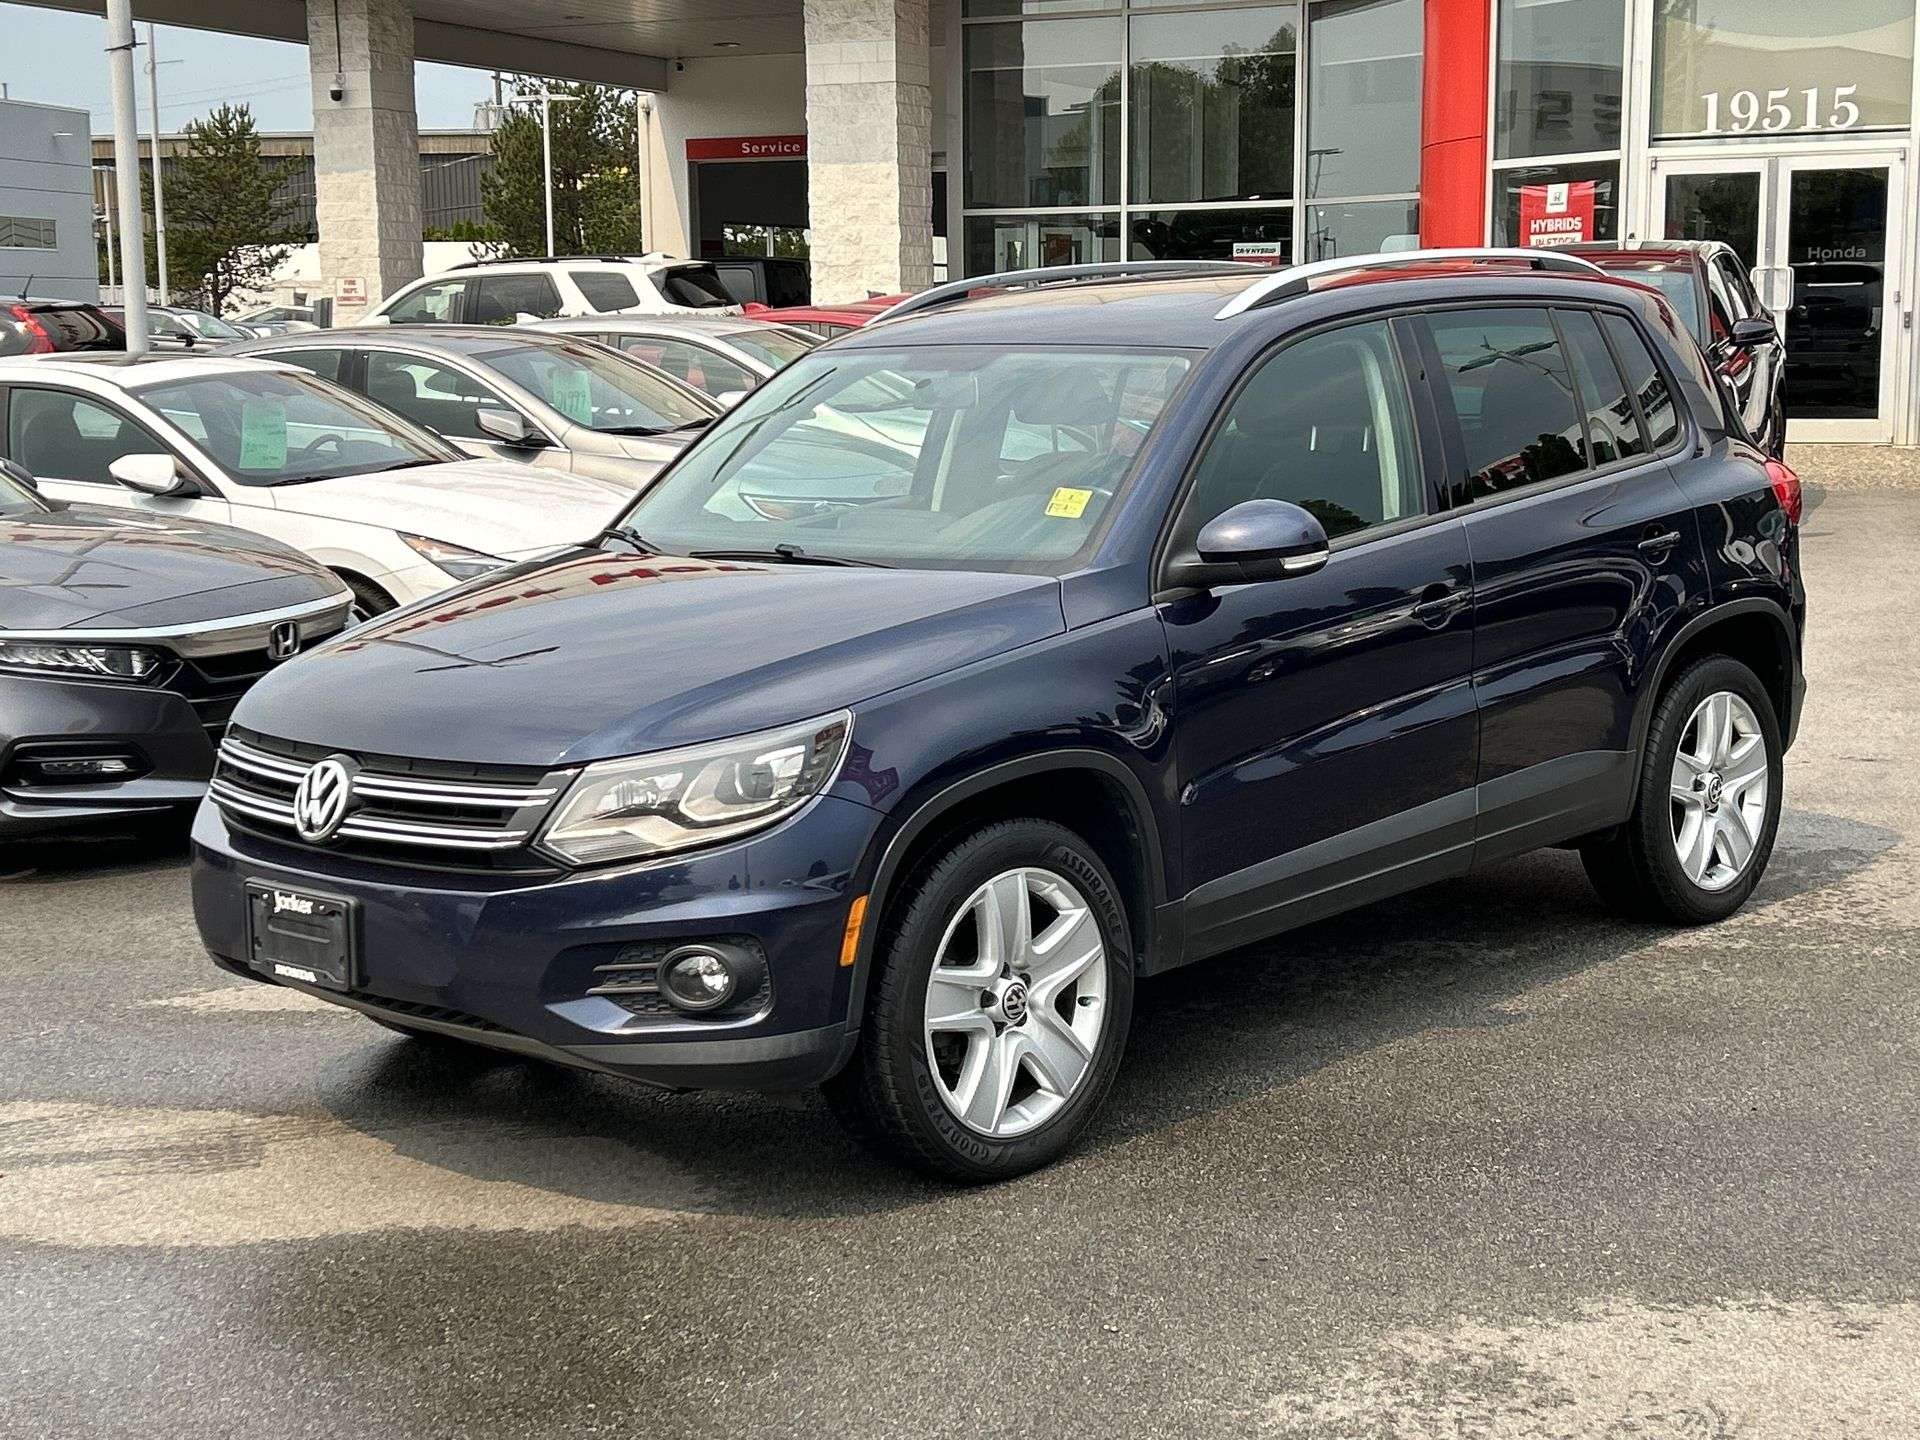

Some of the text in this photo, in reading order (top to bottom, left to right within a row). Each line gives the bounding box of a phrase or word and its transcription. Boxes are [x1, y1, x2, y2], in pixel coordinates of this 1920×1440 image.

[1701, 84, 1859, 133] 19515
[741, 141, 801, 154] Service
[1530, 216, 1582, 233] HYBRIDS
[1808, 246, 1866, 259] Honda
[1060, 851, 1123, 935] ASSURANCE
